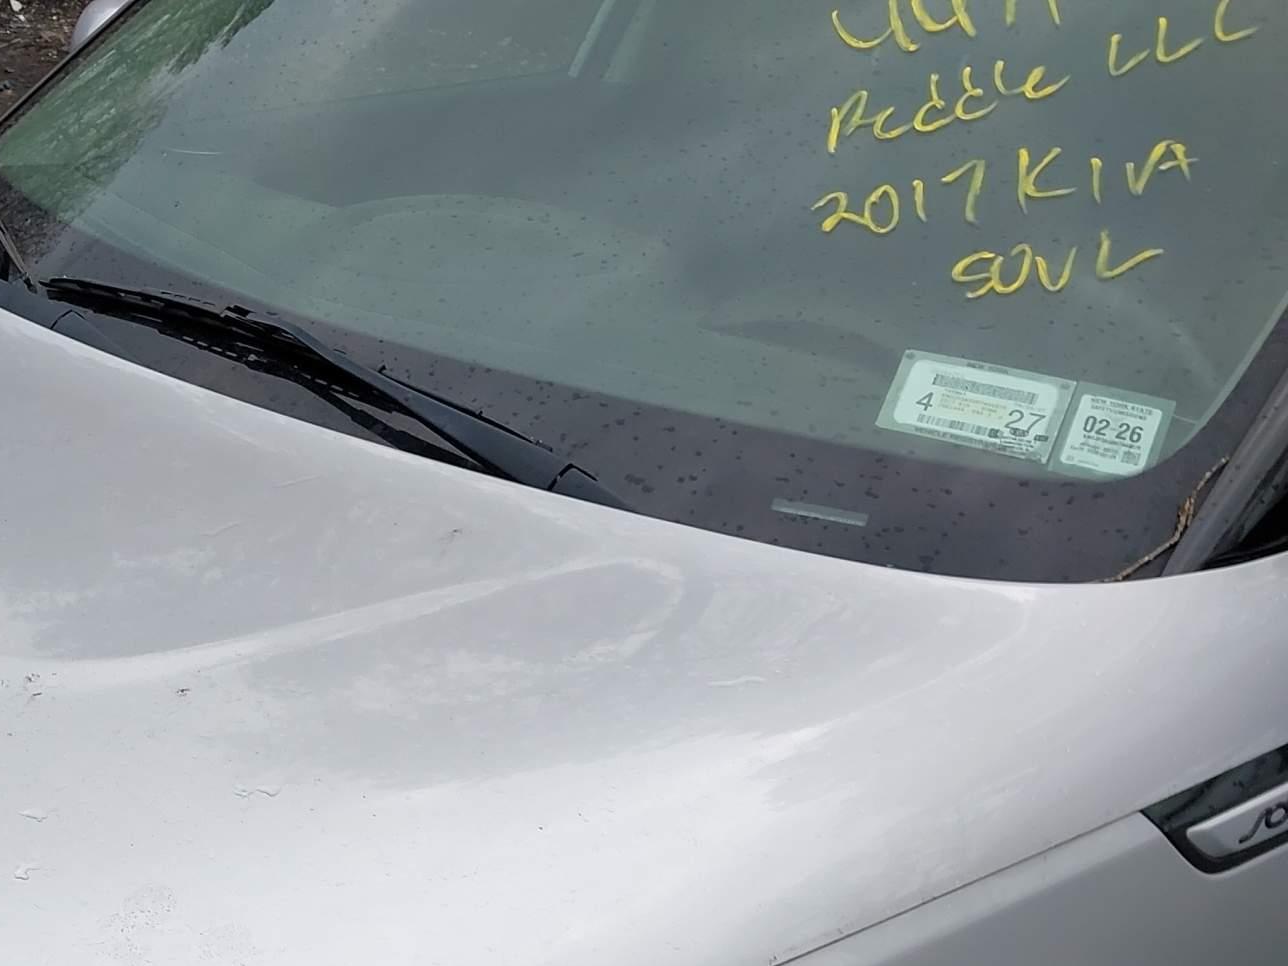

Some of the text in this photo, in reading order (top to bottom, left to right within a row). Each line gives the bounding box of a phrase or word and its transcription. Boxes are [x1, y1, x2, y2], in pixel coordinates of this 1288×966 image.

[811, 159, 986, 234] 2017
[951, 229, 1164, 299] SOUL
[915, 392, 934, 412] 4
[1005, 409, 1047, 433] 27
